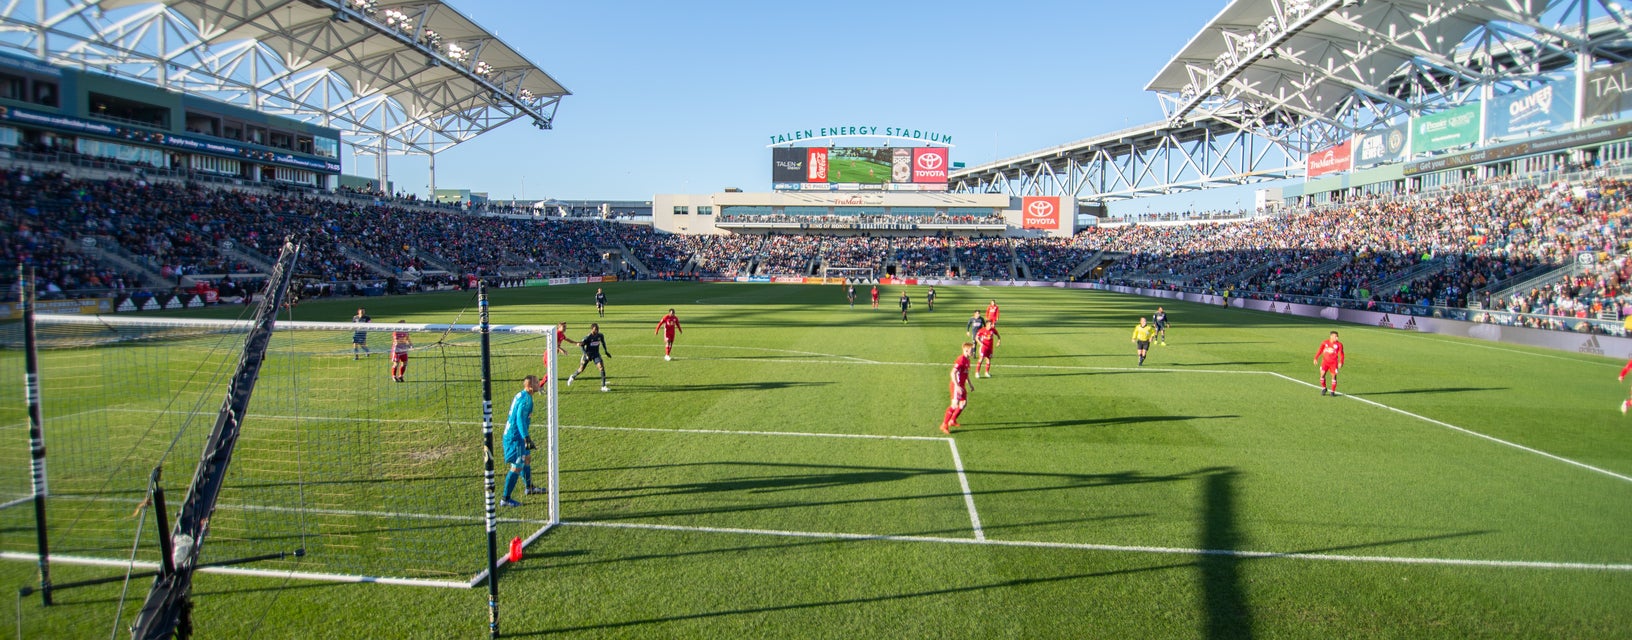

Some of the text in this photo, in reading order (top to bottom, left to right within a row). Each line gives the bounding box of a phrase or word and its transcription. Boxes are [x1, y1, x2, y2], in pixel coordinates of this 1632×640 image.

[1509, 86, 1552, 116] OLIVER
[770, 126, 952, 144] TALEN ENERGY STADIUM
[1310, 157, 1335, 170] TruMark
[1419, 162, 1430, 170] Get
[1431, 159, 1446, 170] your
[1470, 151, 1486, 161] card
[834, 197, 863, 205] TruMark
[1578, 346, 1605, 355] adidas
